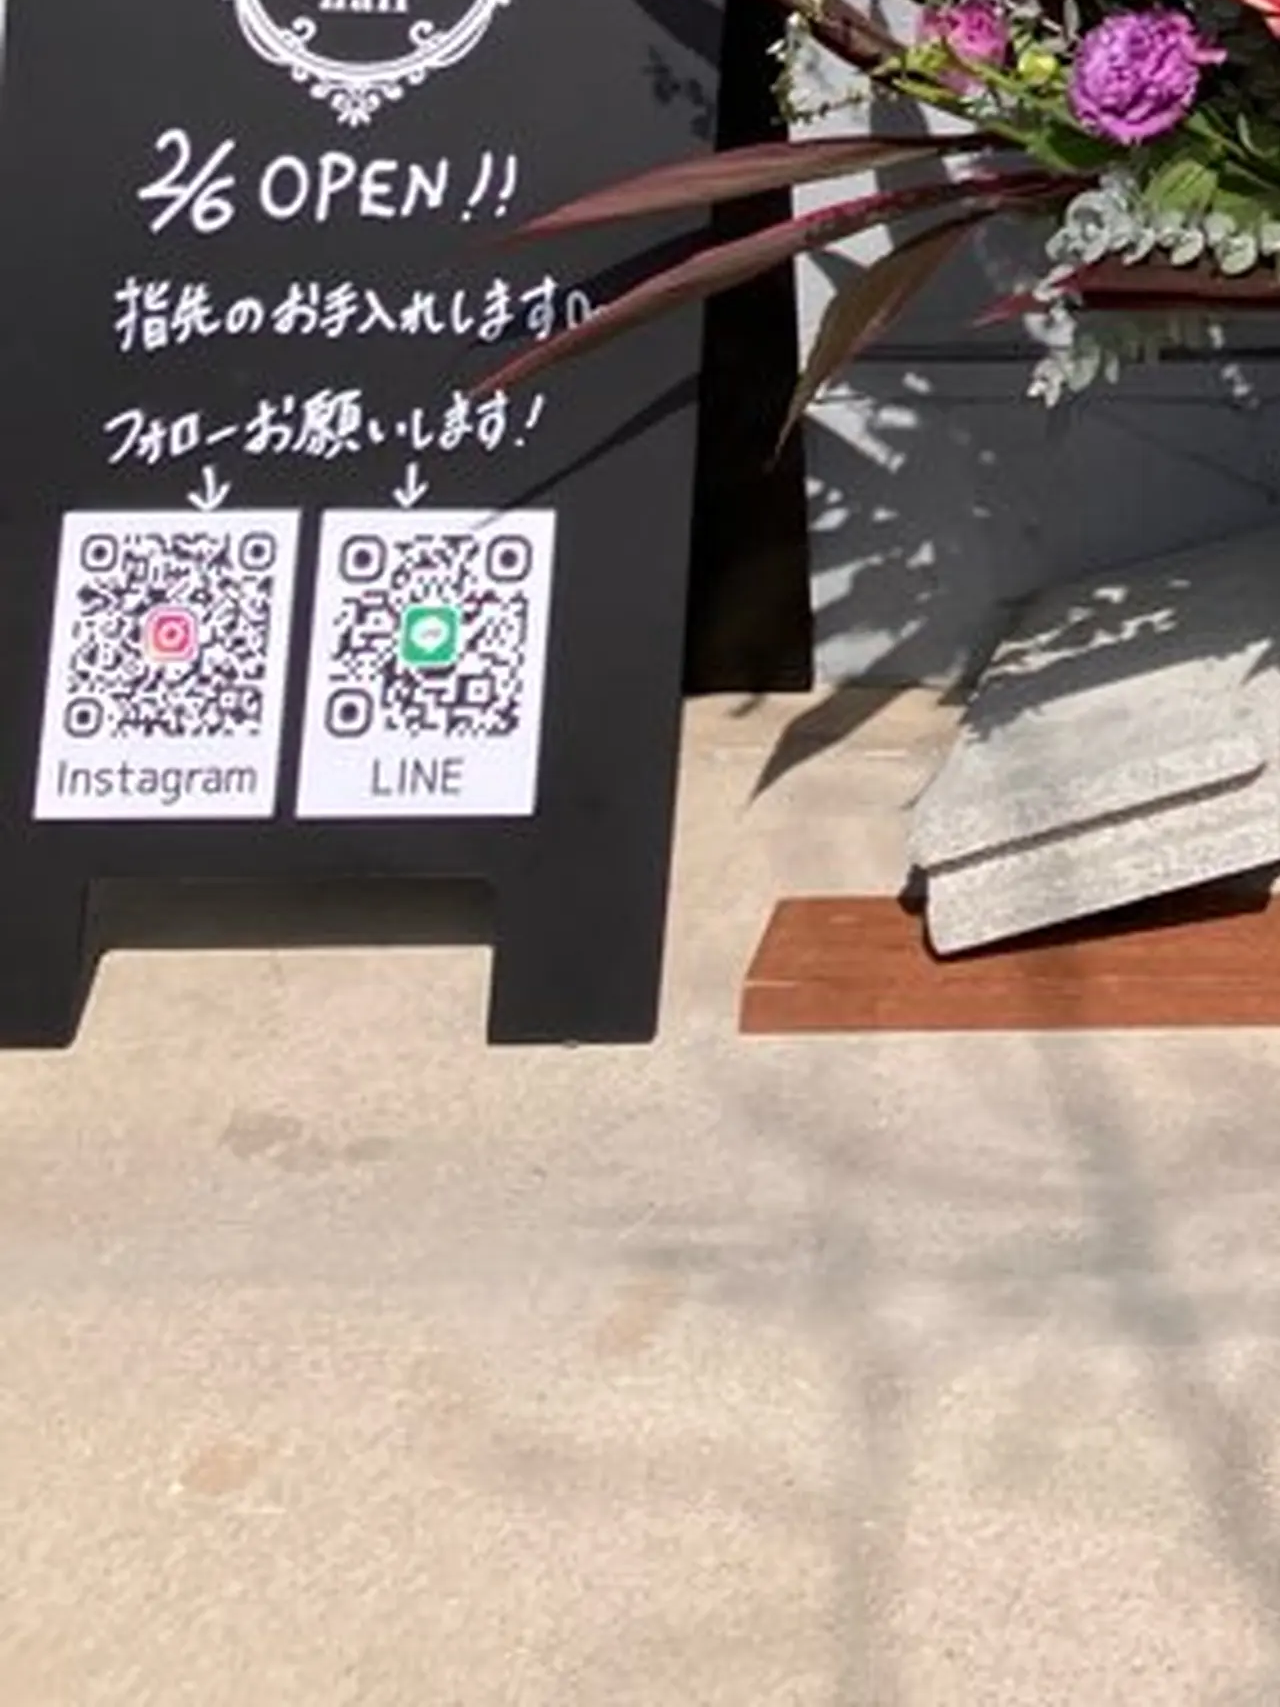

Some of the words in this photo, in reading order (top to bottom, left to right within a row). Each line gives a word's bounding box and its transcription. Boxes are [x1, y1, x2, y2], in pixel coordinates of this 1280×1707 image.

[137, 127, 237, 234] 2/6
[55, 759, 259, 805] Instagram
[369, 757, 465, 797] LINE
